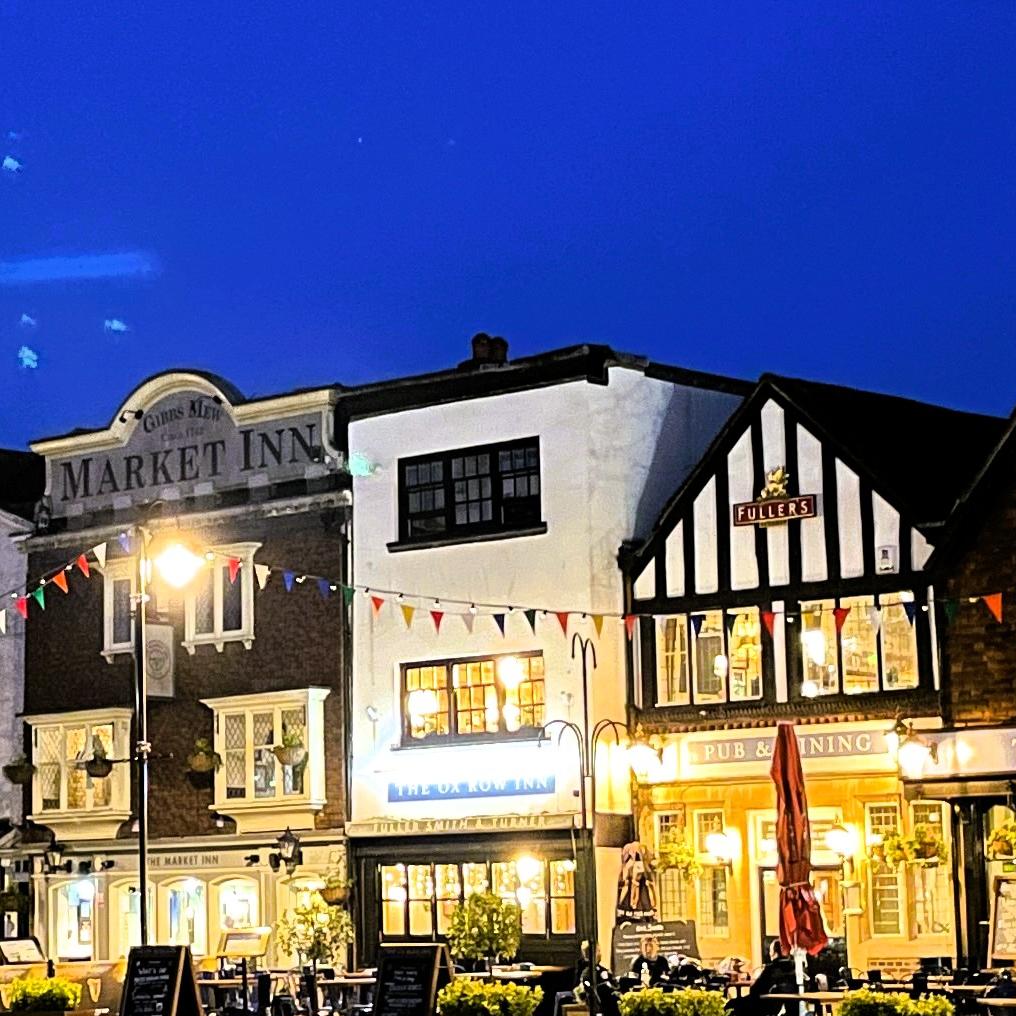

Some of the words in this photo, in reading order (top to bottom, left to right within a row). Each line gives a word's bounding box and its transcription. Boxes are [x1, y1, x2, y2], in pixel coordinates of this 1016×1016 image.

[60, 440, 225, 501] MARKET
[239, 423, 315, 472] INN
[738, 500, 808, 521] FULLER'S
[704, 742, 746, 761] PUB
[755, 741, 775, 758] &
[800, 733, 872, 756] INING
[397, 782, 430, 797] THE
[437, 780, 461, 795] OX
[468, 777, 507, 793] ROW
[514, 774, 549, 790] INN
[165, 855, 199, 866] MARKET
[201, 854, 219, 865] INN
